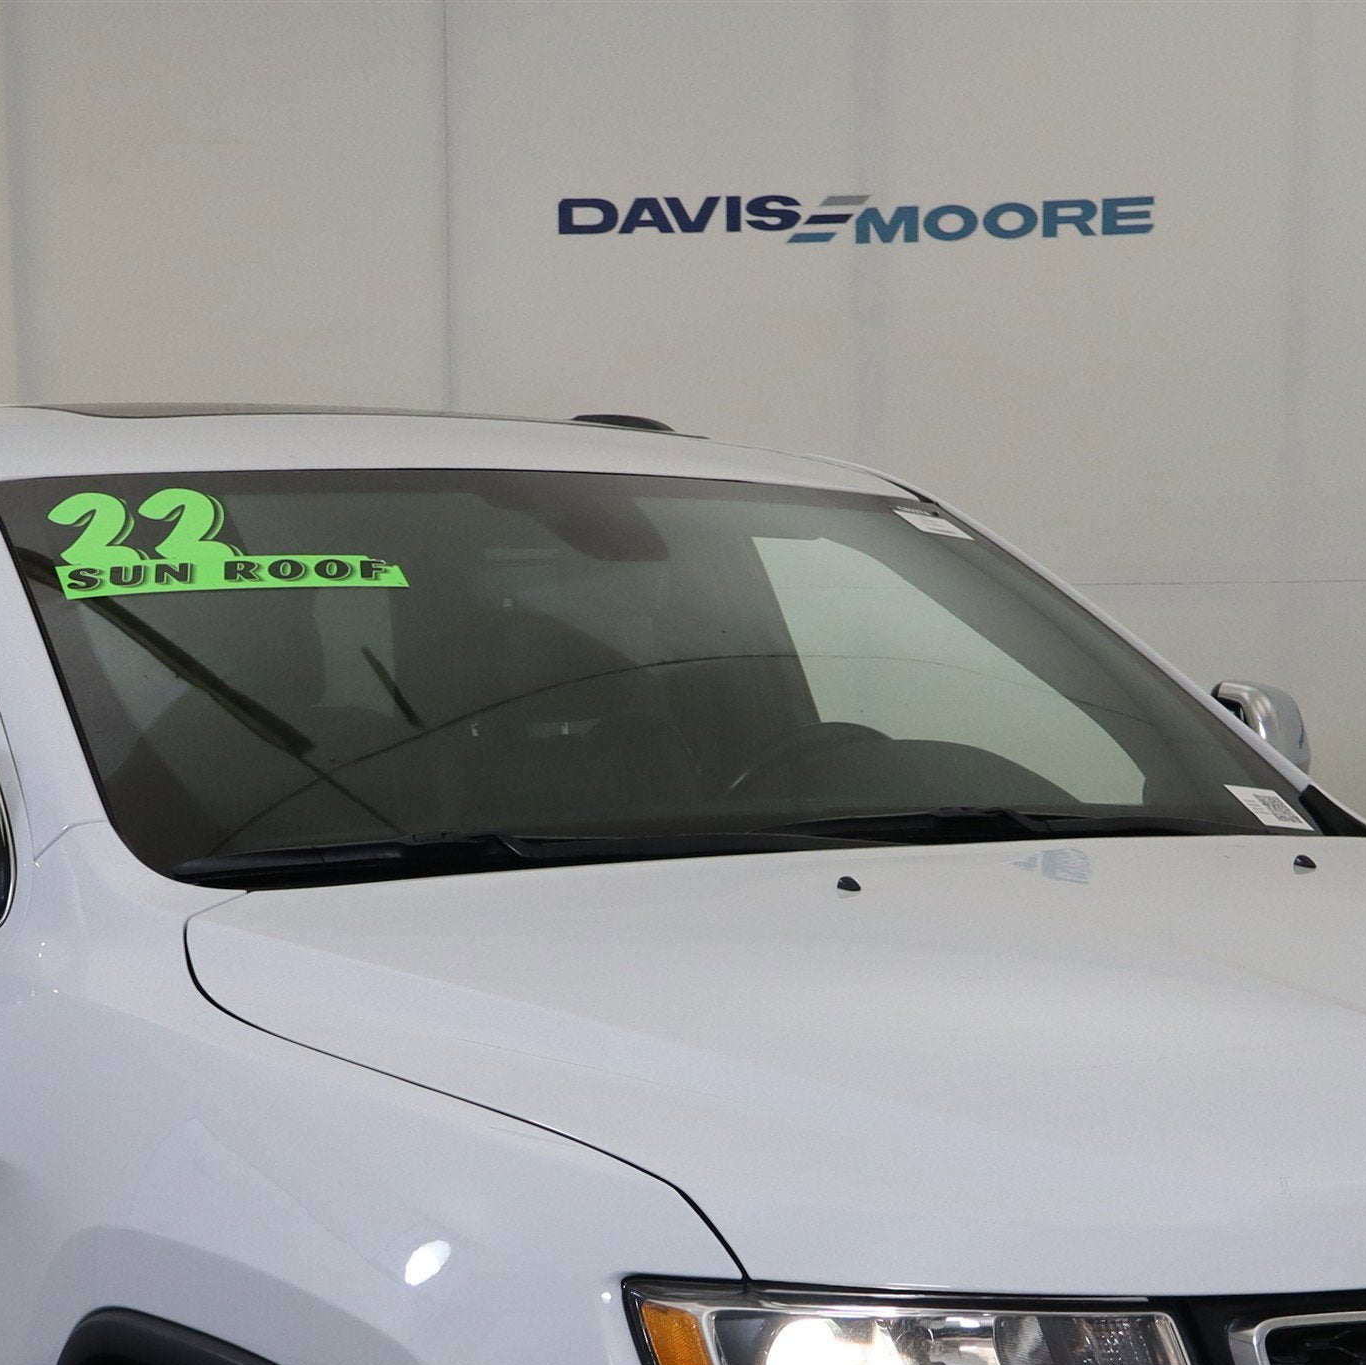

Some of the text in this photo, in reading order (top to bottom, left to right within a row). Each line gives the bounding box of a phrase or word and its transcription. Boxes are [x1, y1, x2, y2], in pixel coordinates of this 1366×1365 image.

[557, 193, 1155, 244] DAVIS MOORE
[47, 487, 241, 564] 22
[67, 557, 391, 592] SUN ROOF
